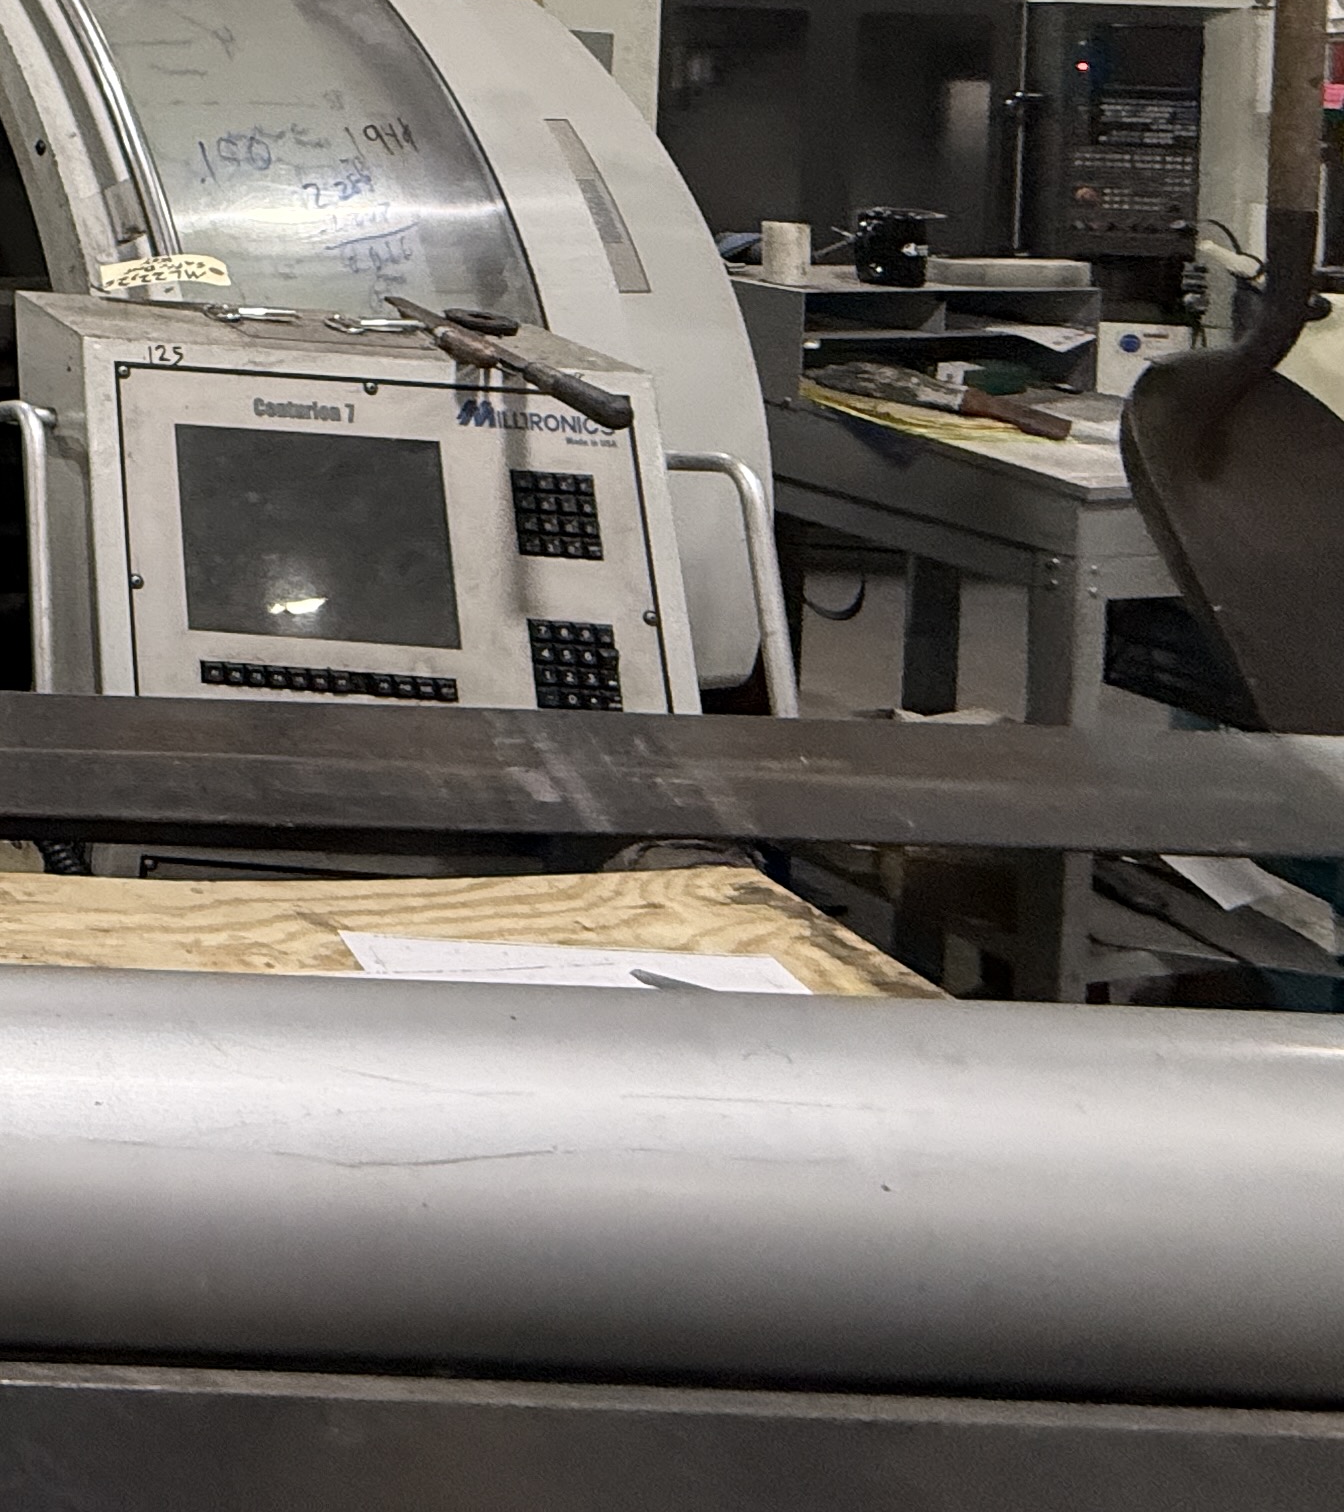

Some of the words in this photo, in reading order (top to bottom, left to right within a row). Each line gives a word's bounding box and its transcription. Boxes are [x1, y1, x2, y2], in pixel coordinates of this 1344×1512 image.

[253, 397, 341, 422] Centurion
[344, 404, 355, 423] 7
[456, 399, 616, 435] MILLTRONIC
